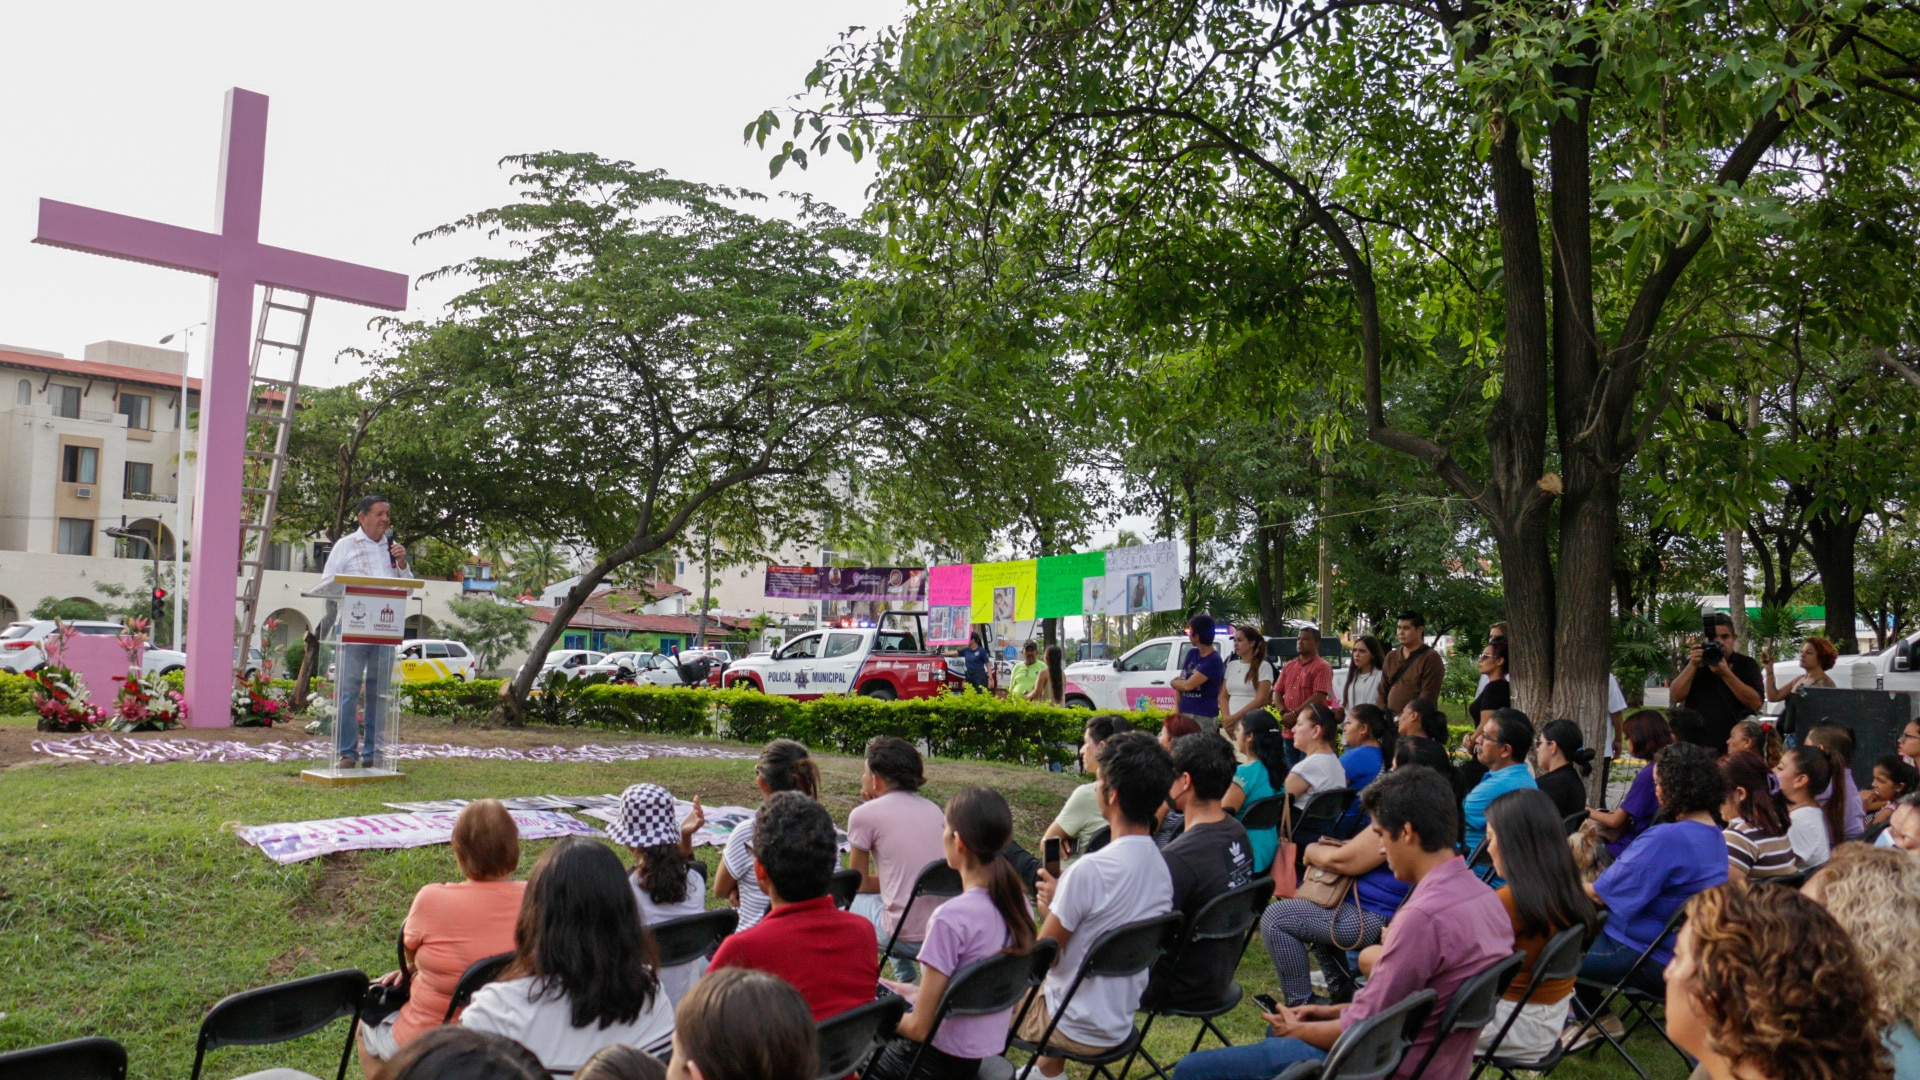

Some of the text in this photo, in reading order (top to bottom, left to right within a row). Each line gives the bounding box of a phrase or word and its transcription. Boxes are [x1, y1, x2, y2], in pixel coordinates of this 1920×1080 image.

[768, 670, 846, 684] POLICÍA MUNICIPAL
[1081, 674, 1106, 682] PV-350
